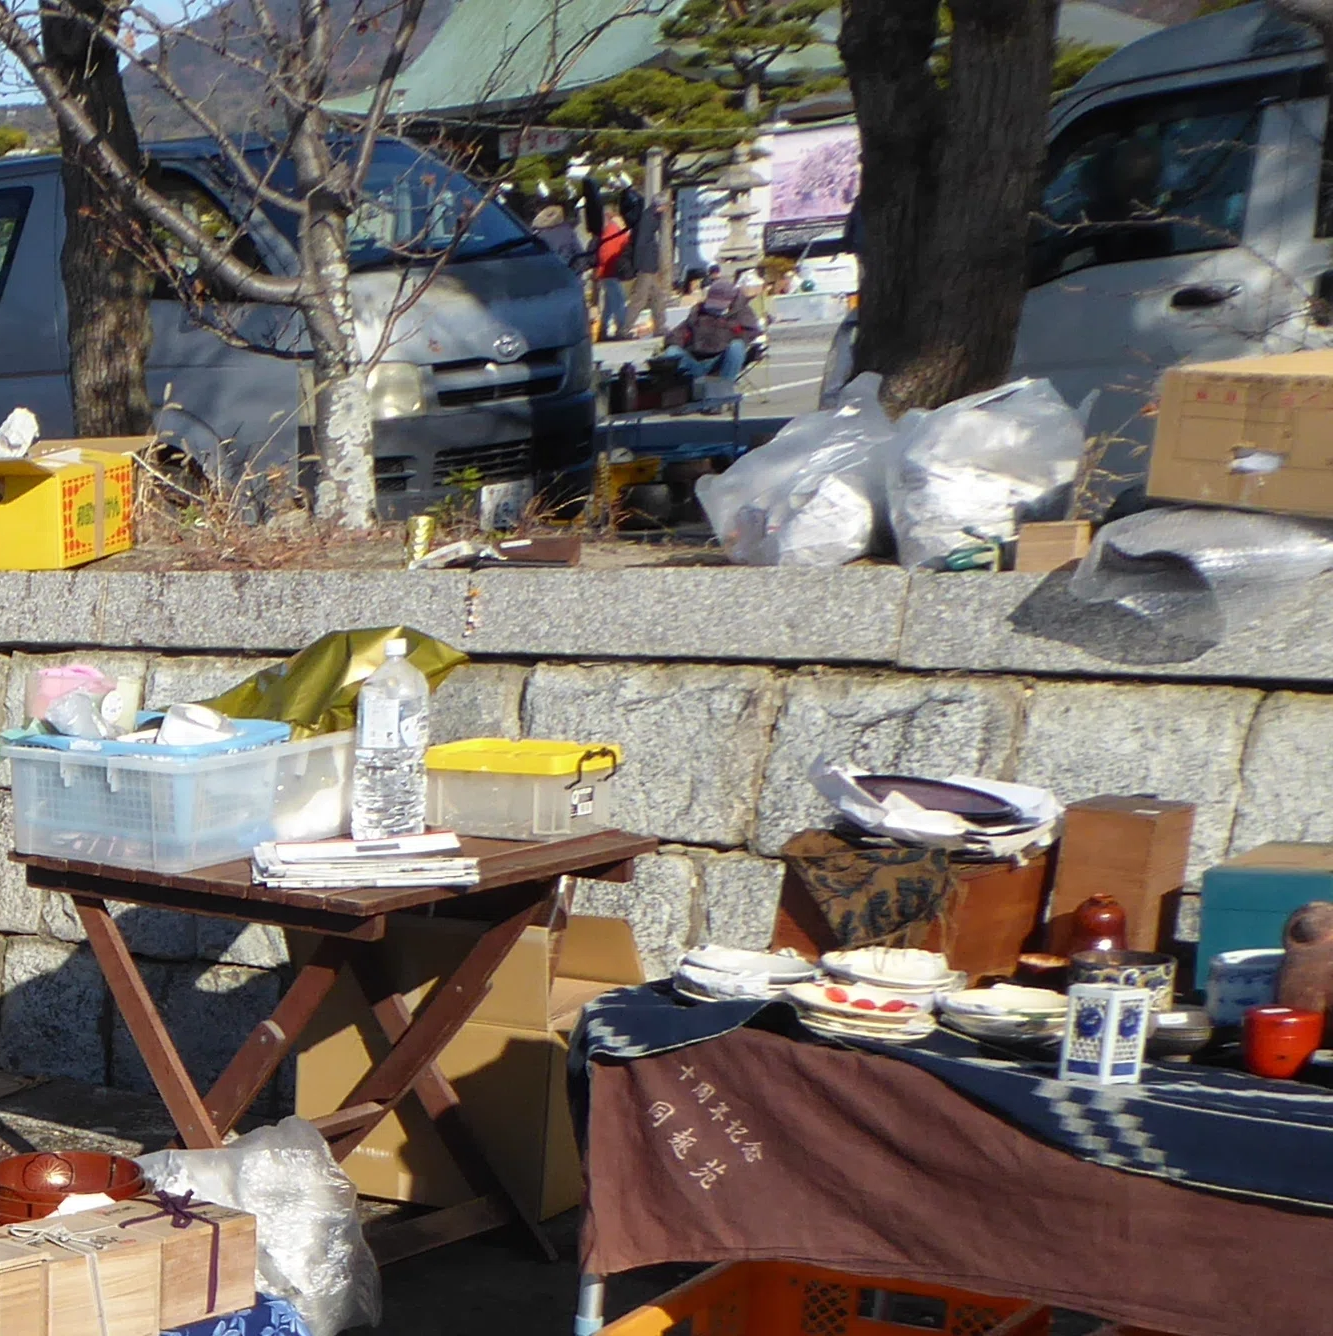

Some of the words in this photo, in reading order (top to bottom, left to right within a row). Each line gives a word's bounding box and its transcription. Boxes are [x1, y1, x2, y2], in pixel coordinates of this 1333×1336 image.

[679, 1064, 763, 1163] 十周年記念
